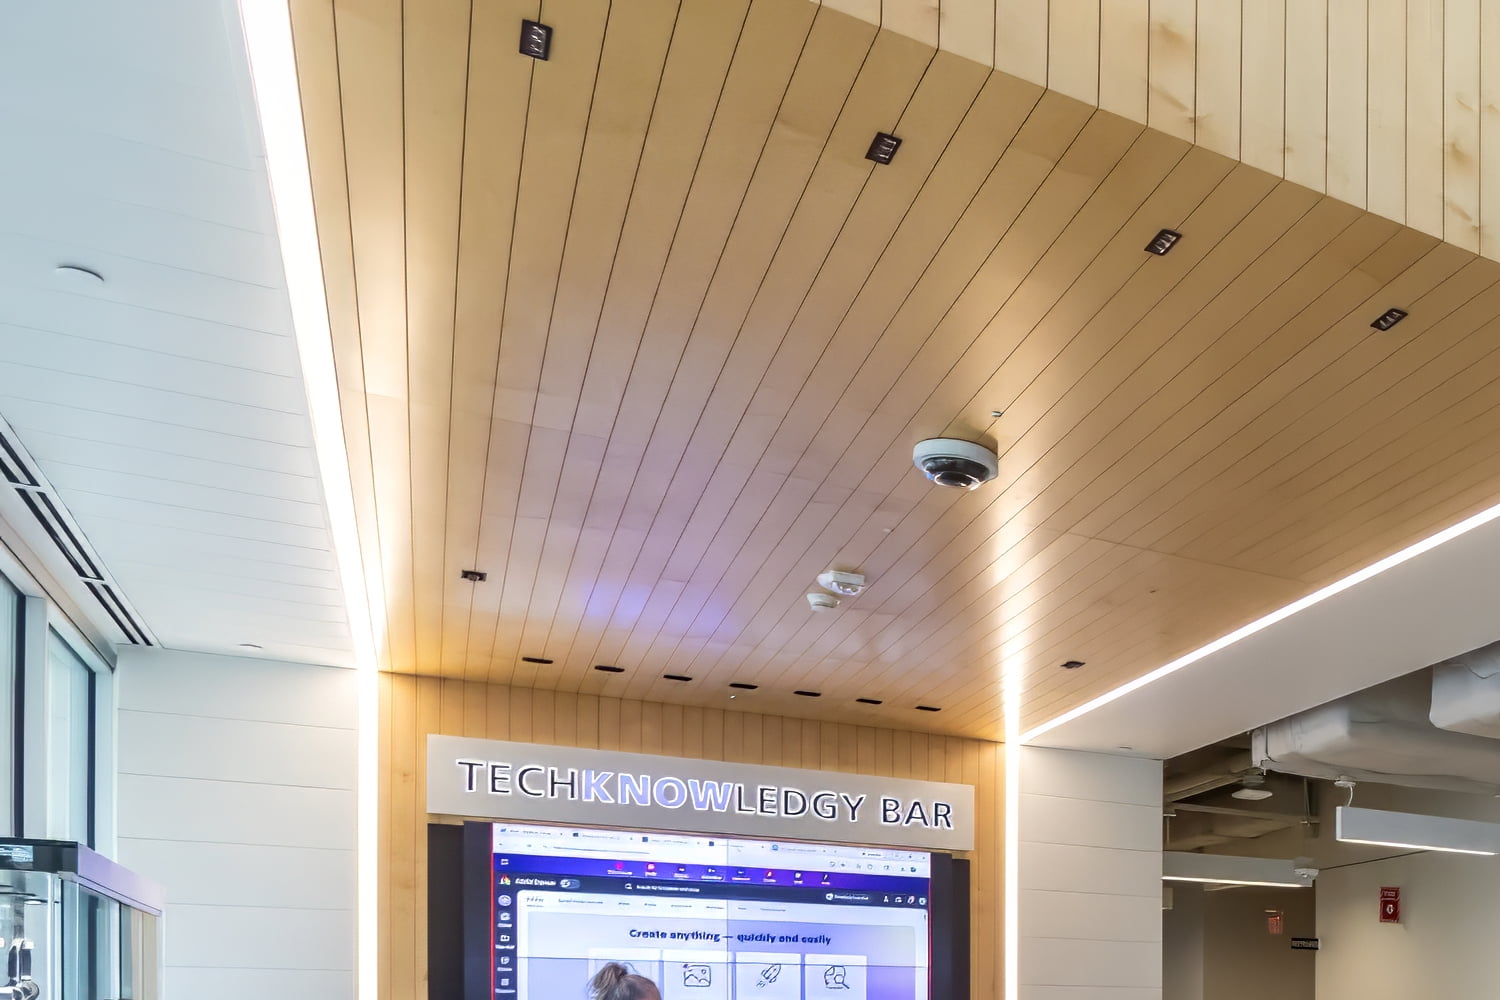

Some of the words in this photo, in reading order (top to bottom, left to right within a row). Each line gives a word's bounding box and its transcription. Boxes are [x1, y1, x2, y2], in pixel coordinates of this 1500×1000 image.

[456, 759, 866, 822] TECHKNOWLEDGY
[880, 796, 955, 829] BAR
[629, 929, 667, 939] Create
[670, 931, 721, 942] anything
[737, 933, 776, 944] quickly
[779, 934, 799, 943] and
[801, 934, 832, 946] easily
